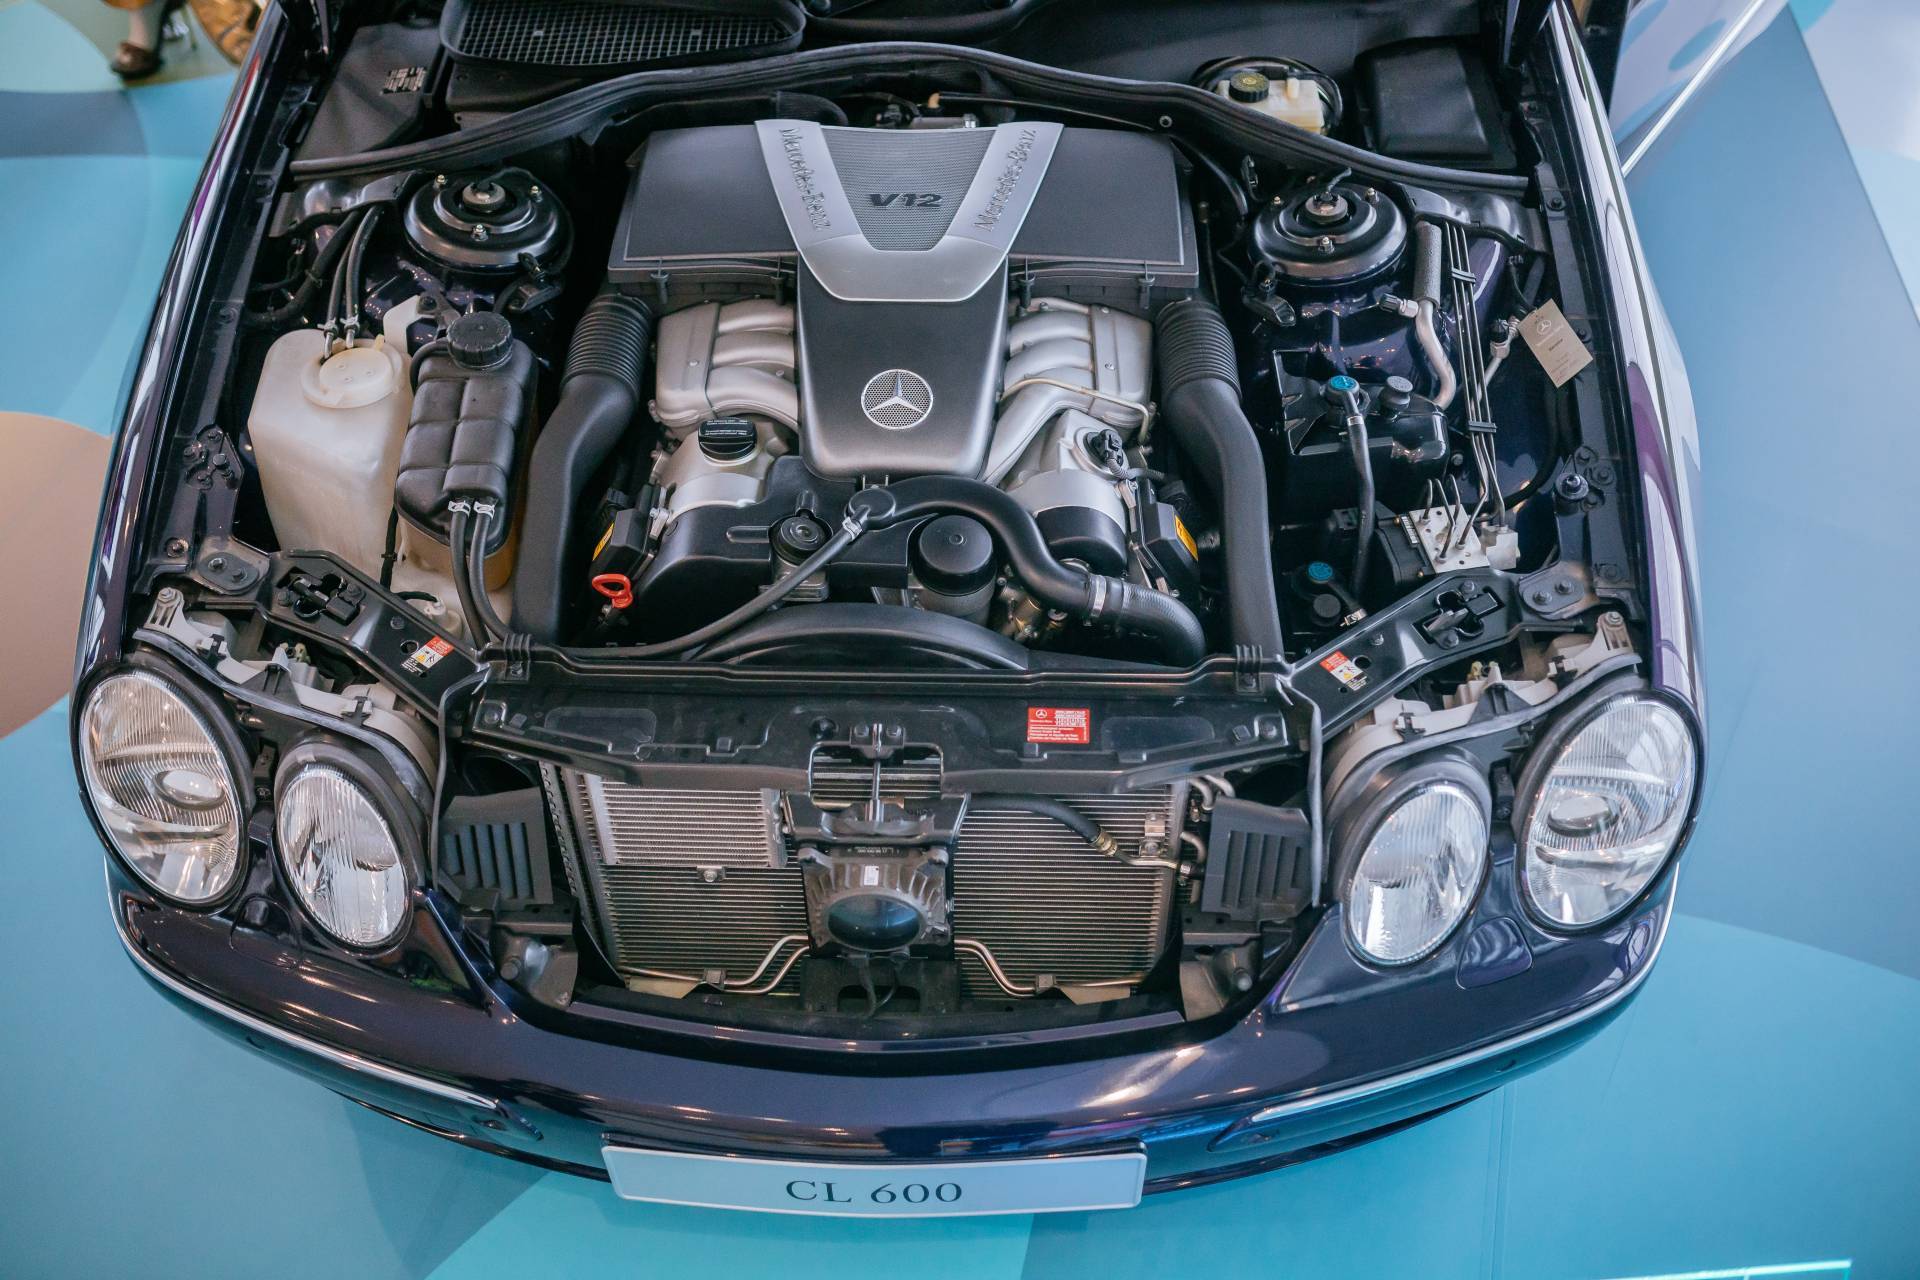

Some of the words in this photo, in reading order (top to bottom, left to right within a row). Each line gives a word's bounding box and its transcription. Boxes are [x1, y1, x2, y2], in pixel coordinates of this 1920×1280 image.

[779, 128, 831, 231] Mercedes-Benz
[869, 193, 943, 208] V12
[974, 129, 1036, 232] Mercedes-Benz
[786, 1180, 852, 1203] CL
[870, 1182, 962, 1204] 600
